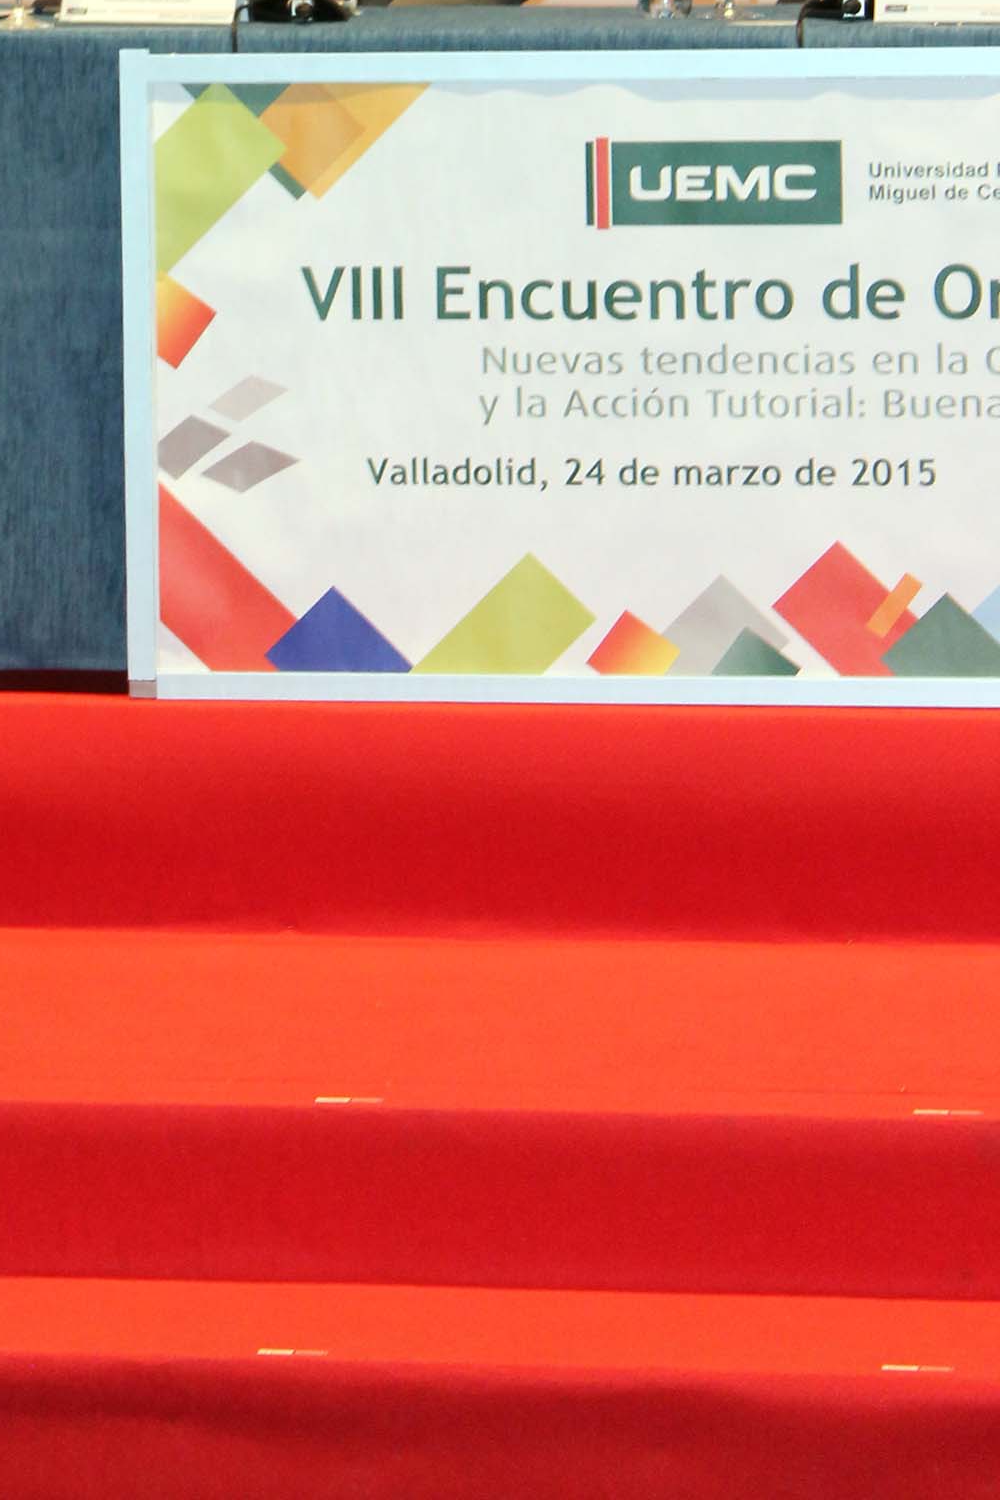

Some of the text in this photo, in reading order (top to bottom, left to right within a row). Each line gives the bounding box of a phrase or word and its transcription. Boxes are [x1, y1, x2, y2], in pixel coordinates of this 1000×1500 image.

[629, 164, 817, 201] UEMC
[868, 161, 989, 179] Universidad
[868, 183, 936, 204] Miguel
[944, 184, 969, 201] de
[301, 264, 404, 322] VIII
[436, 264, 794, 322] Encuentro
[822, 262, 906, 321] de
[481, 345, 625, 377] Nuevas
[639, 343, 856, 377] tendencias
[871, 350, 920, 376] en
[936, 341, 969, 376] la
[479, 394, 500, 428] y
[516, 384, 548, 419] la
[563, 386, 690, 420] Acción
[706, 384, 867, 420] Tutorial:
[367, 455, 936, 492] Valladolid, 24 de marzo de 2015
